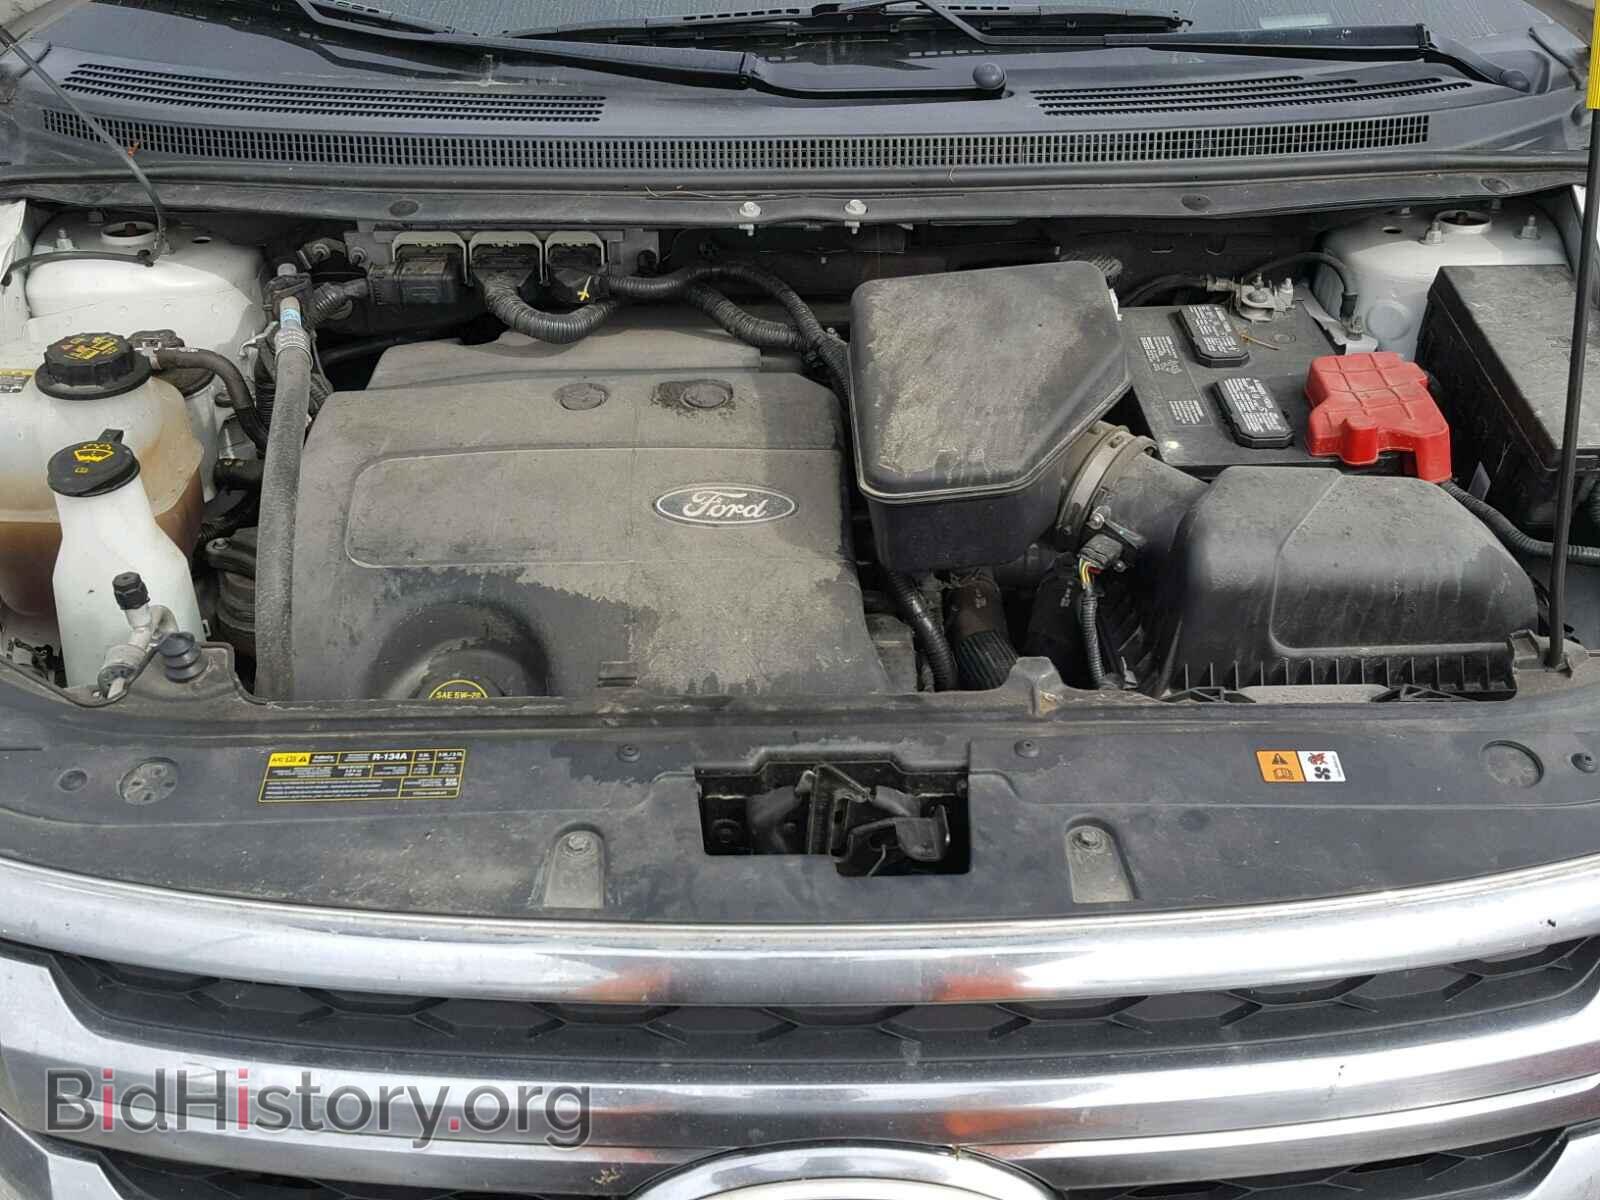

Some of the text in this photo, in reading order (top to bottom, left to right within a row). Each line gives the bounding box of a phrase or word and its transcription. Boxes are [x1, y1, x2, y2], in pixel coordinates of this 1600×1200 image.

[682, 490, 769, 518] Ford
[435, 690, 454, 699] SAE
[372, 752, 408, 761] R-134A
